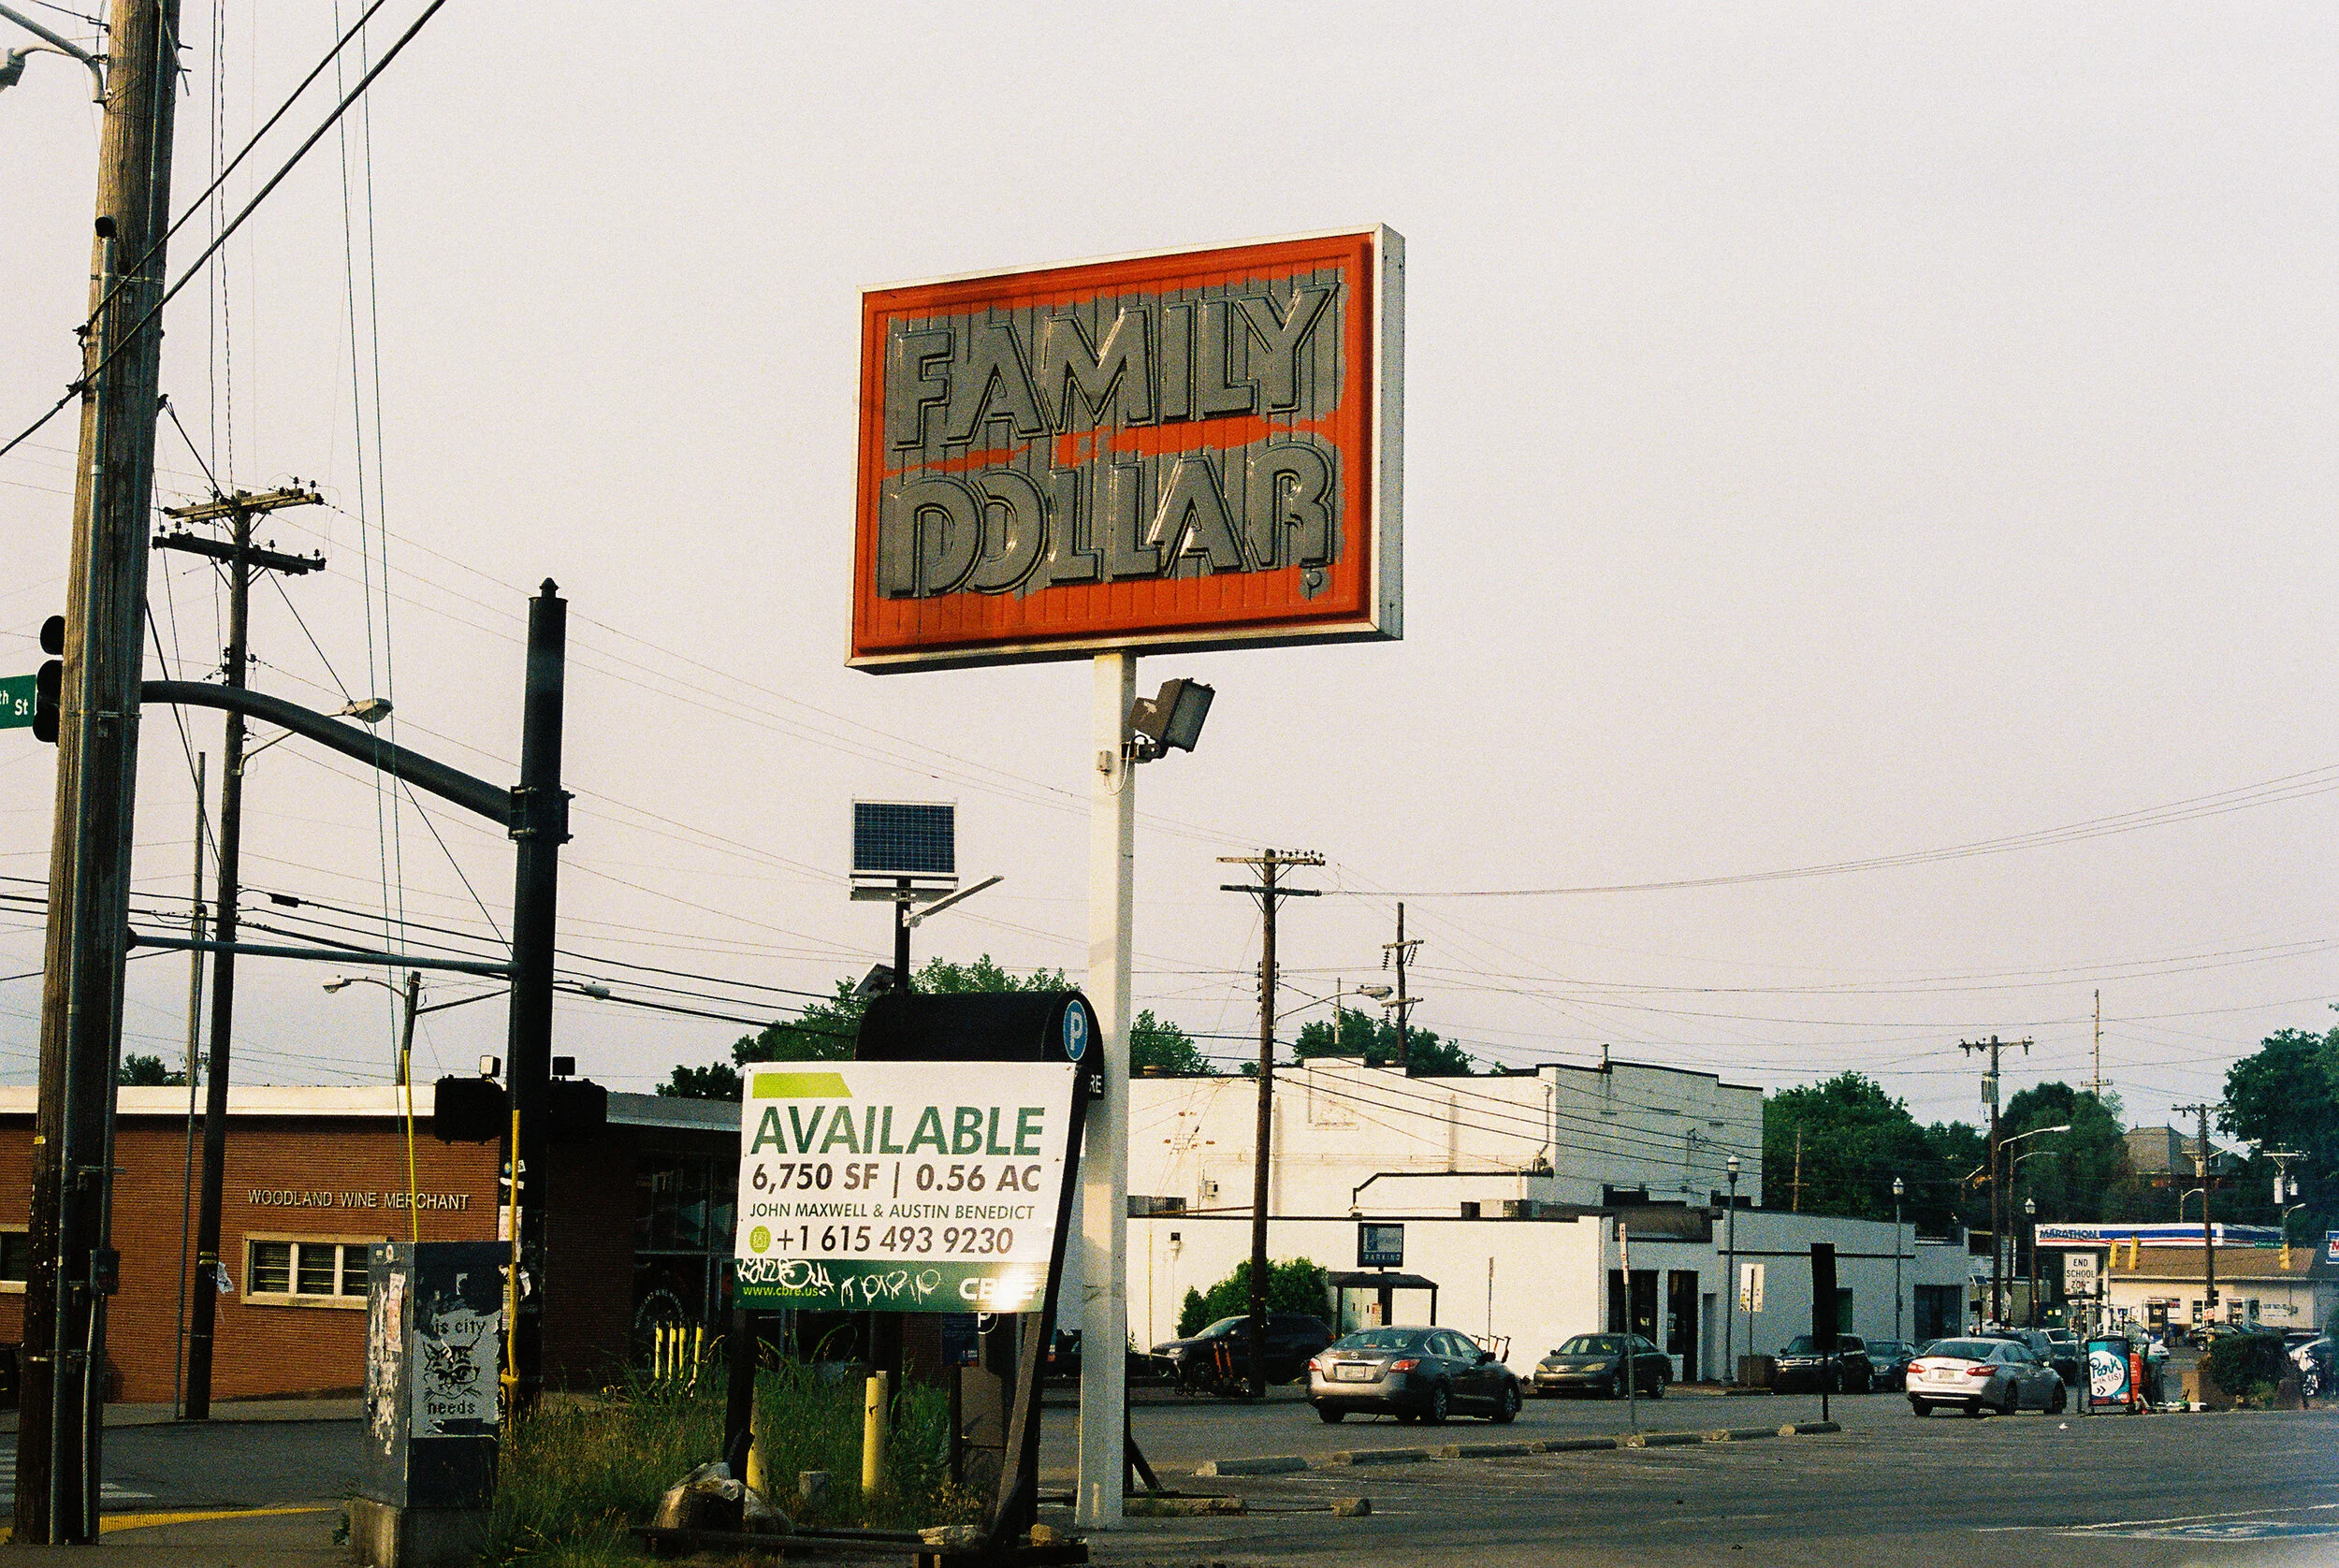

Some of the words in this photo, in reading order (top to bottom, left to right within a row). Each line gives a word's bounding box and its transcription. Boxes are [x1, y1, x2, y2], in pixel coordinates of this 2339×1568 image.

[893, 283, 1340, 451] FAMILY
[887, 442, 1335, 598] DOLLAR
[14, 698, 28, 716] St
[1069, 1011, 1083, 1051] P
[1088, 1074, 1102, 1094] RE
[750, 1106, 1045, 1155] AVAILABLE
[752, 1163, 833, 1194] 6,750
[844, 1163, 879, 1190] SF
[916, 1164, 986, 1192] 0.56
[995, 1165, 1041, 1192] AC
[248, 1189, 333, 1207] WOODLAND
[341, 1192, 377, 1207] WINE
[384, 1193, 470, 1210] MERCHANT
[749, 1203, 791, 1217] JOHN
[795, 1203, 867, 1217] MAXWELL
[873, 1204, 884, 1217] &
[890, 1204, 949, 1218] AUSTIN
[955, 1205, 1035, 1220] BENEDICT
[777, 1226, 808, 1251] +1
[821, 1226, 871, 1252] 615
[879, 1227, 933, 1253] 493
[943, 1227, 1013, 1254] 9230
[2039, 1227, 2098, 1240] MARATHON
[2073, 1258, 2088, 1267] END
[2066, 1269, 2096, 1278] SCHOOL
[743, 1285, 819, 1297] www.cbre.us
[2070, 1280, 2090, 1289] ZON
[455, 1318, 487, 1338] city
[2090, 1357, 2121, 1379] Park
[428, 1401, 476, 1416] needs
